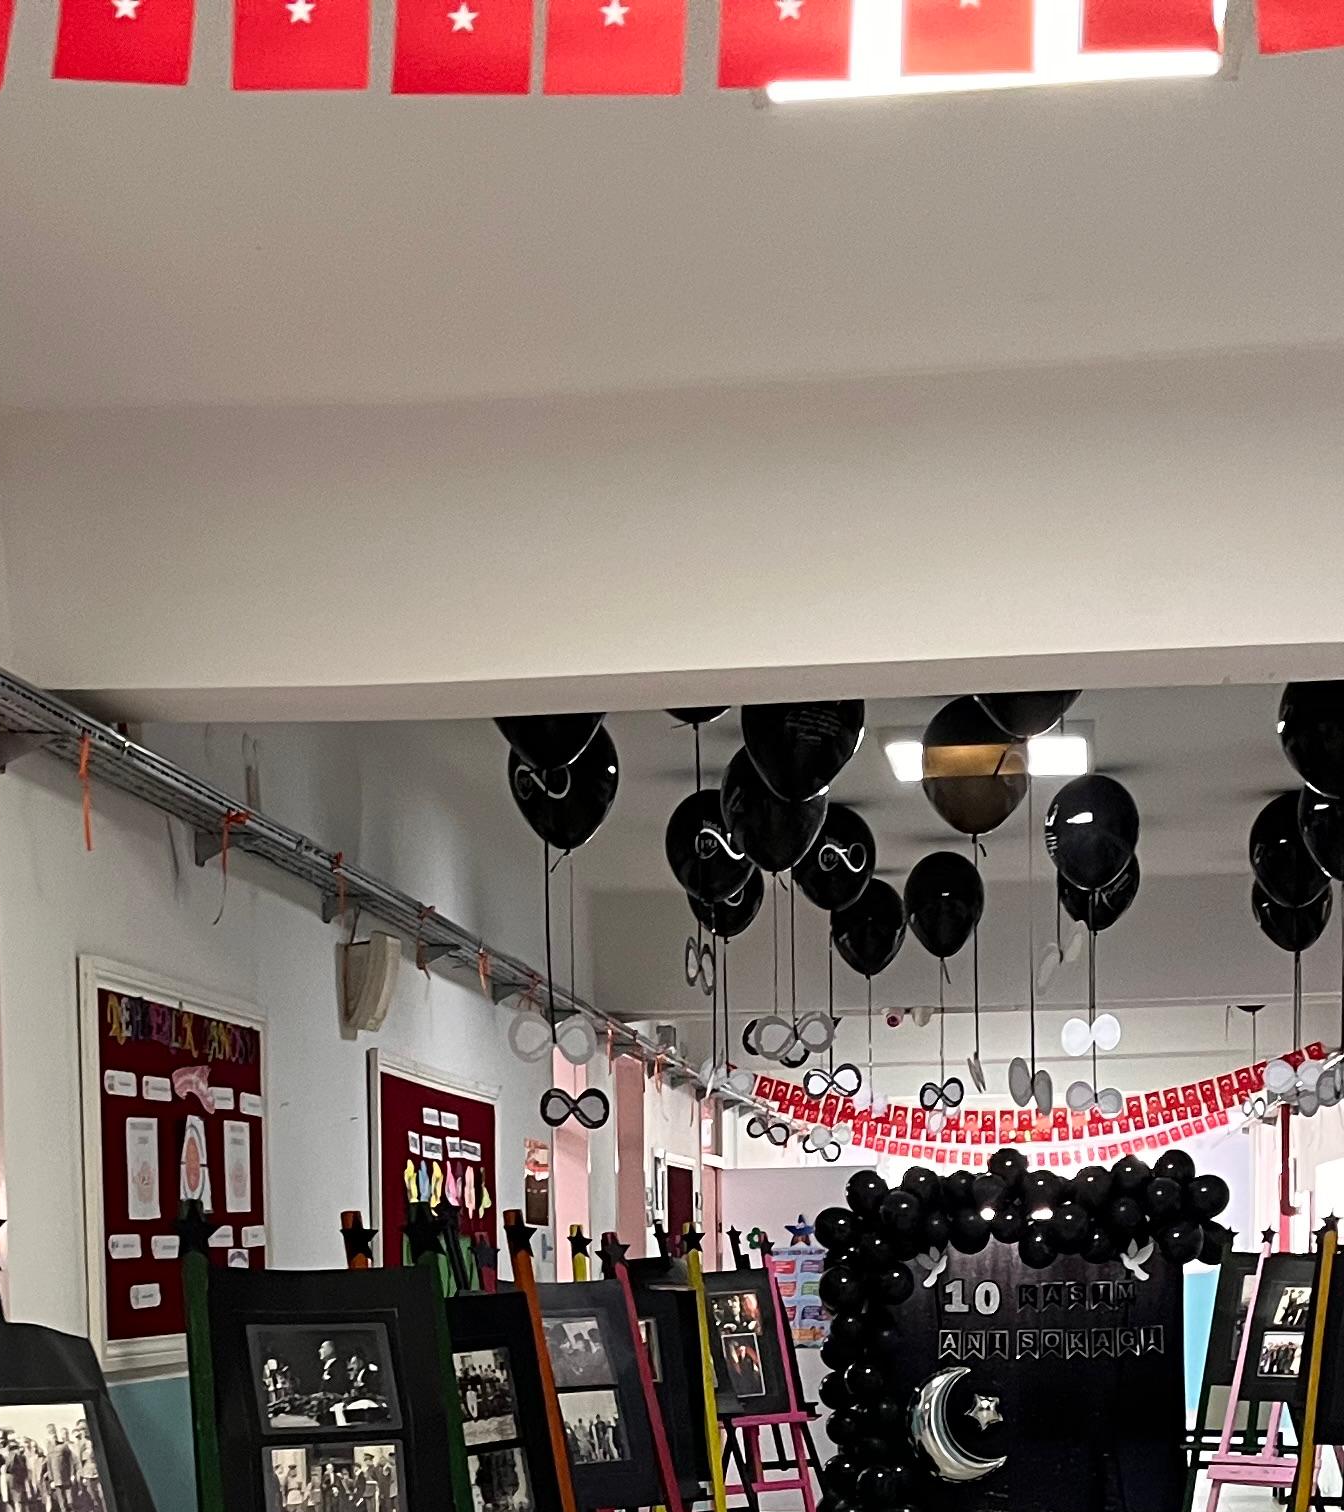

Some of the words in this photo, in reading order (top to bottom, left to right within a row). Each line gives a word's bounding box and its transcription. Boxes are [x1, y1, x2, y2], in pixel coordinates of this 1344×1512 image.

[944, 1280, 1001, 1315] 10
[1021, 1284, 1135, 1302] KASIM
[942, 1333, 1002, 1349] ANI
